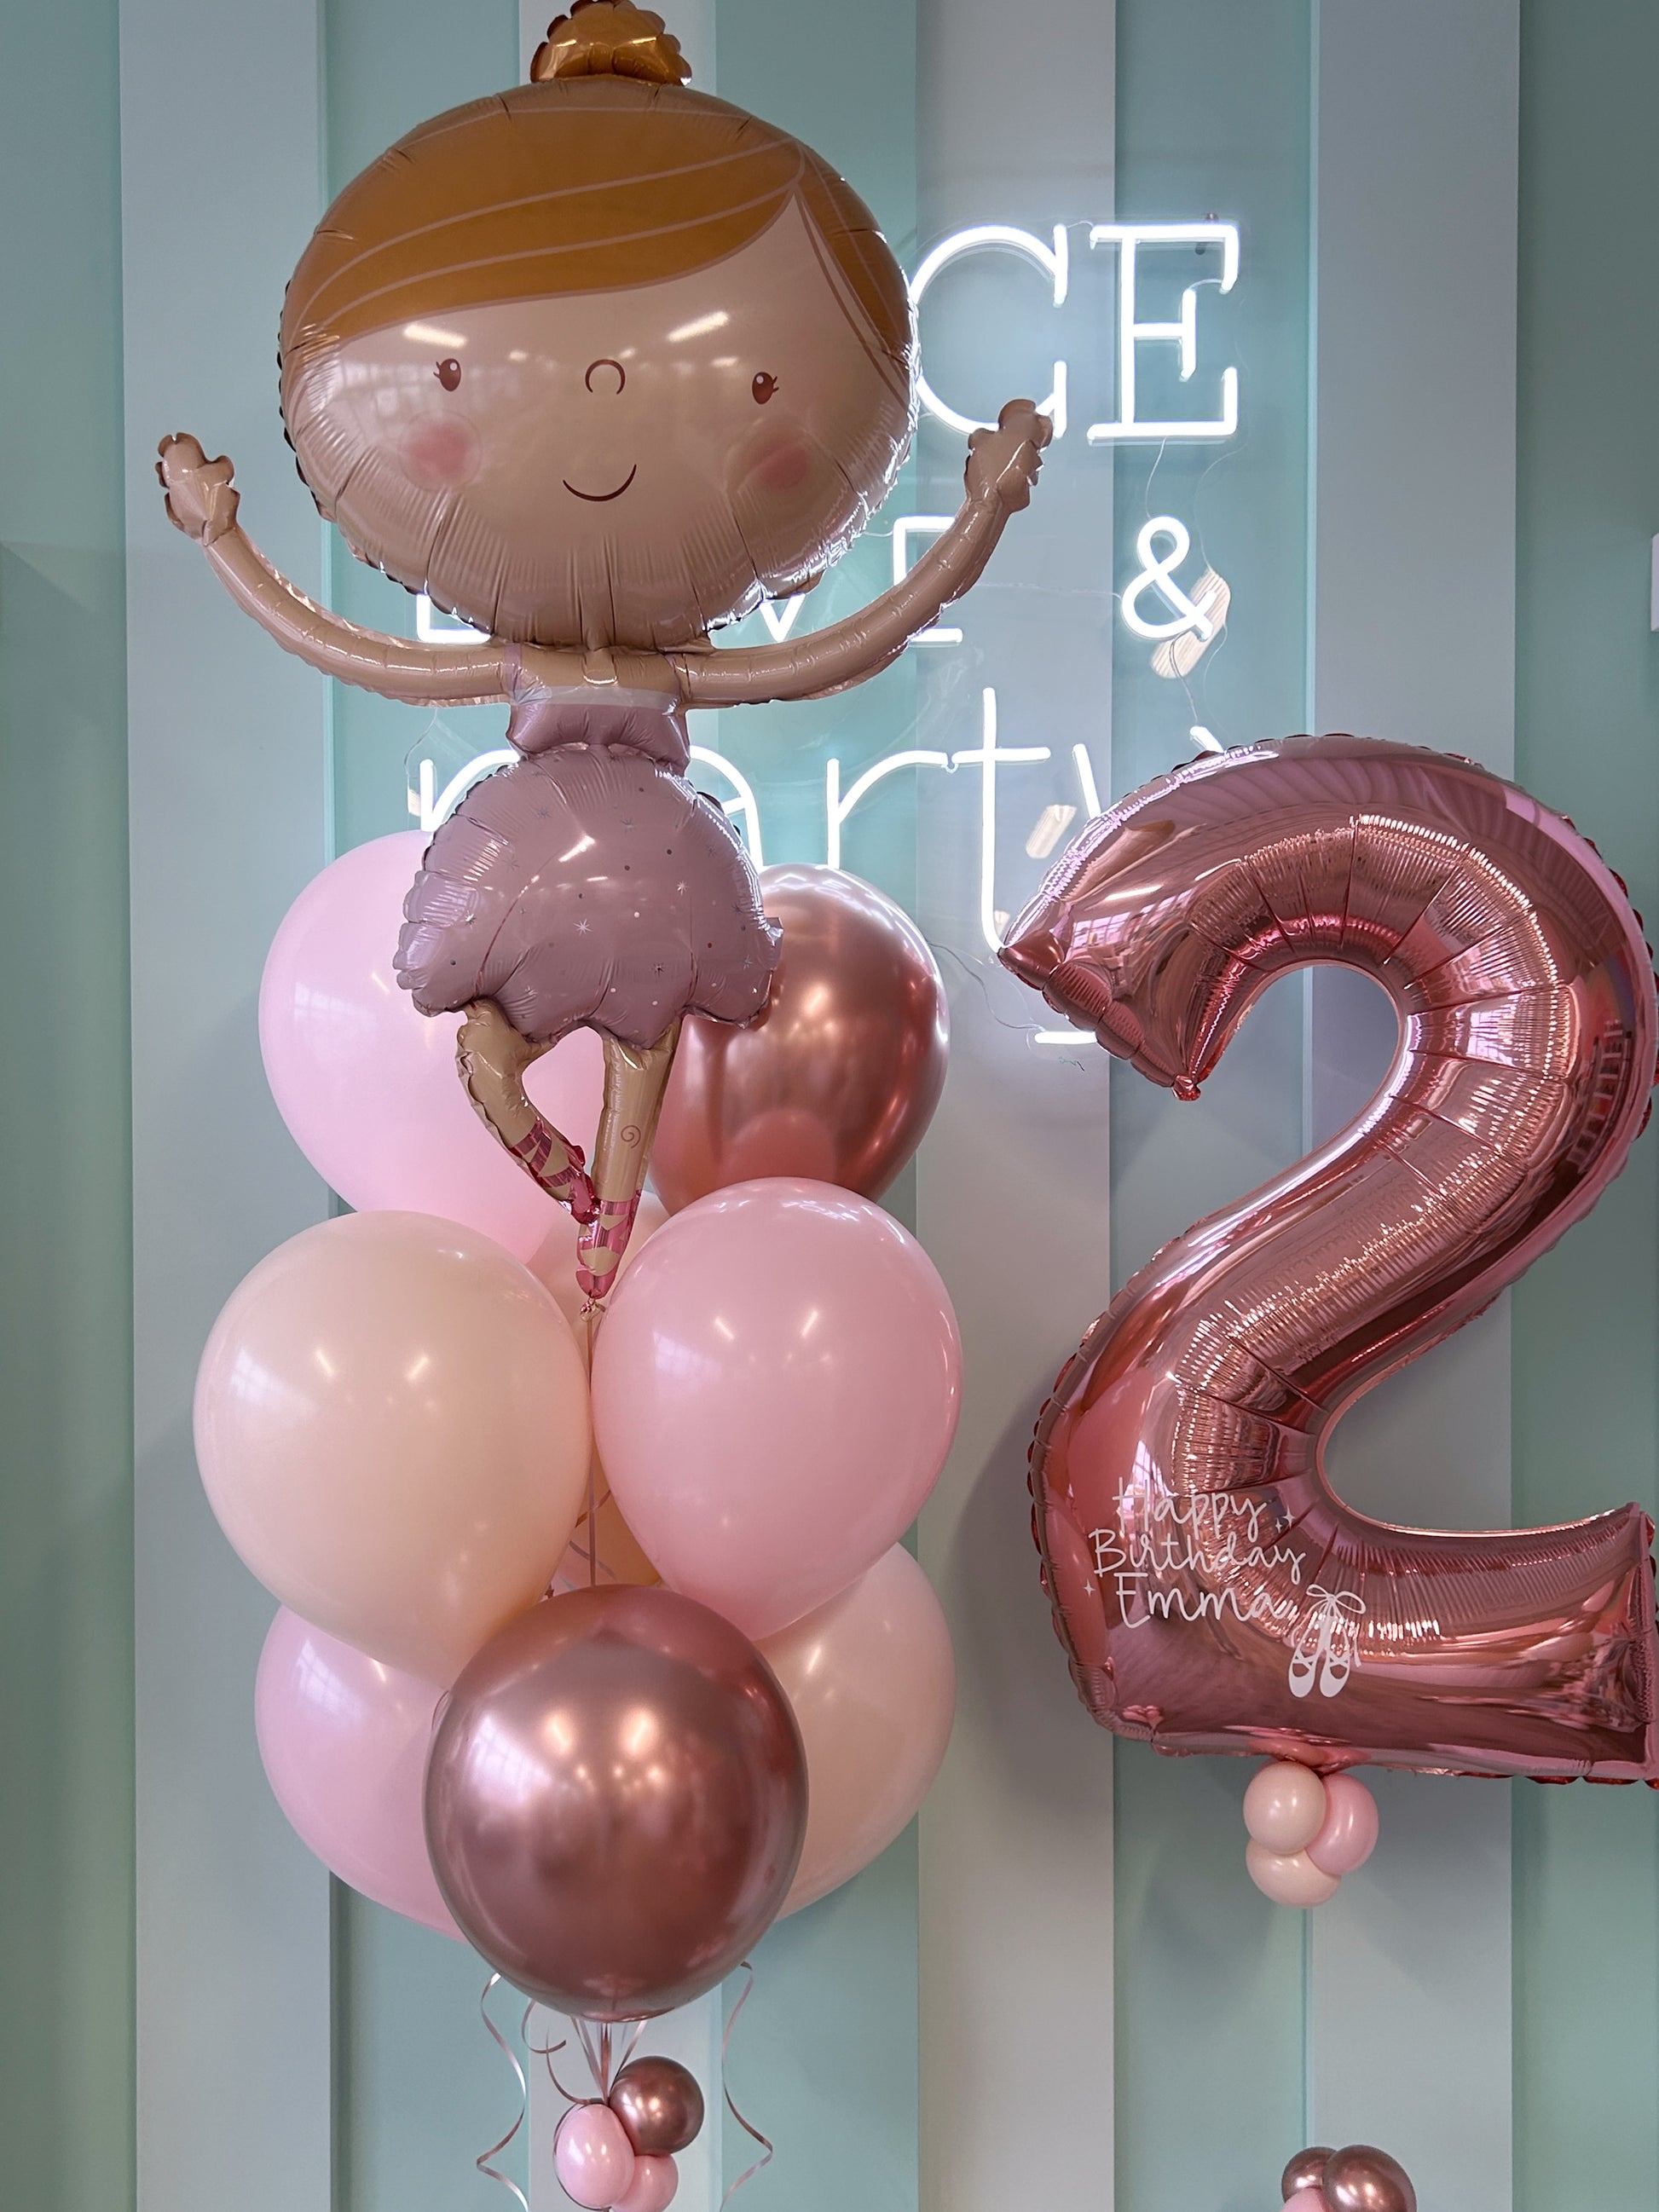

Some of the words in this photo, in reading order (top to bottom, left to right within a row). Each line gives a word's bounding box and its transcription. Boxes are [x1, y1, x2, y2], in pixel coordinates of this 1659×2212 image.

[1120, 515, 1214, 641] &
[1112, 1476, 1268, 1542] Happy
[1088, 1528, 1306, 1585] Birthday
[1113, 1572, 1293, 1629] Emma
